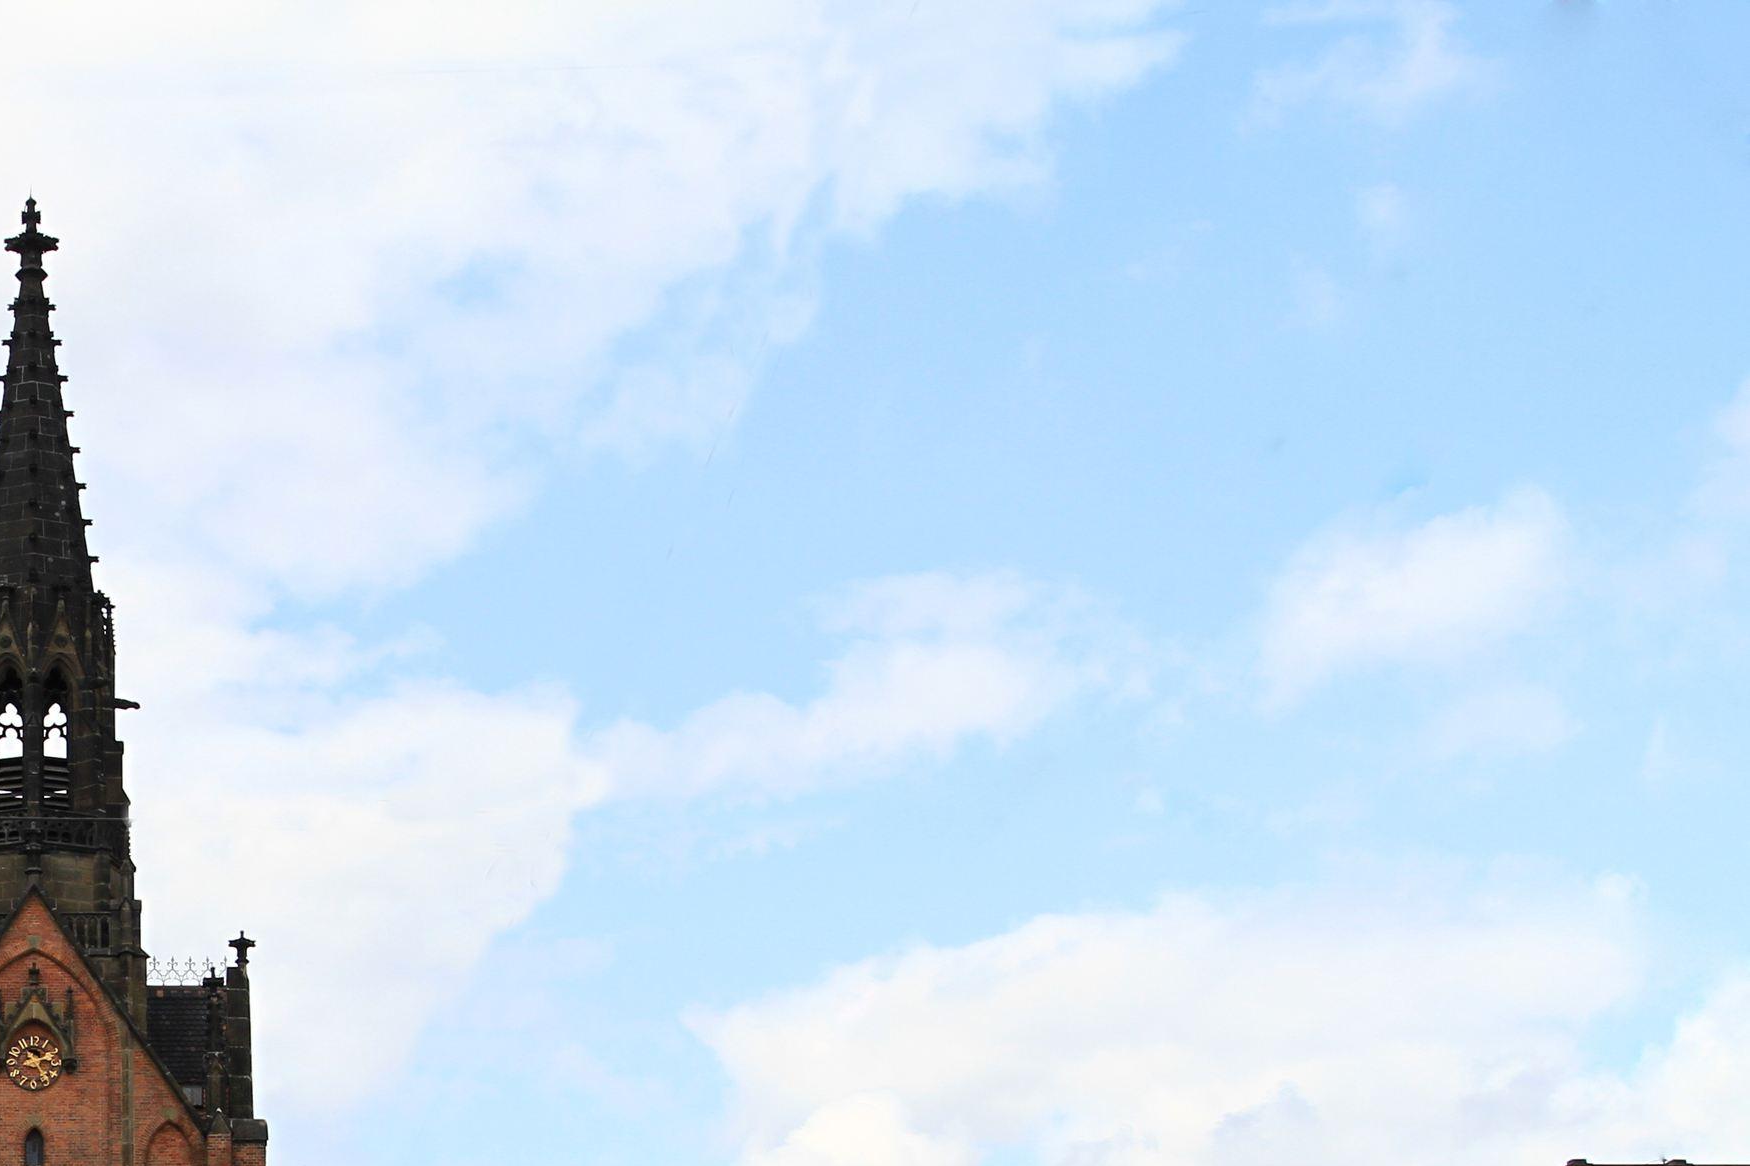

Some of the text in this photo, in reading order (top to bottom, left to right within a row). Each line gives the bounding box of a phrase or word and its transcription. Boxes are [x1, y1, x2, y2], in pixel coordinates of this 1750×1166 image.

[18, 1038, 28, 1049] 11
[30, 1036, 40, 1046] 12
[42, 1039, 49, 1048] 1
[8, 1046, 21, 1057] 10
[50, 1059, 62, 1067] 3
[10, 1069, 20, 1077] 8
[19, 1075, 28, 1086] 7
